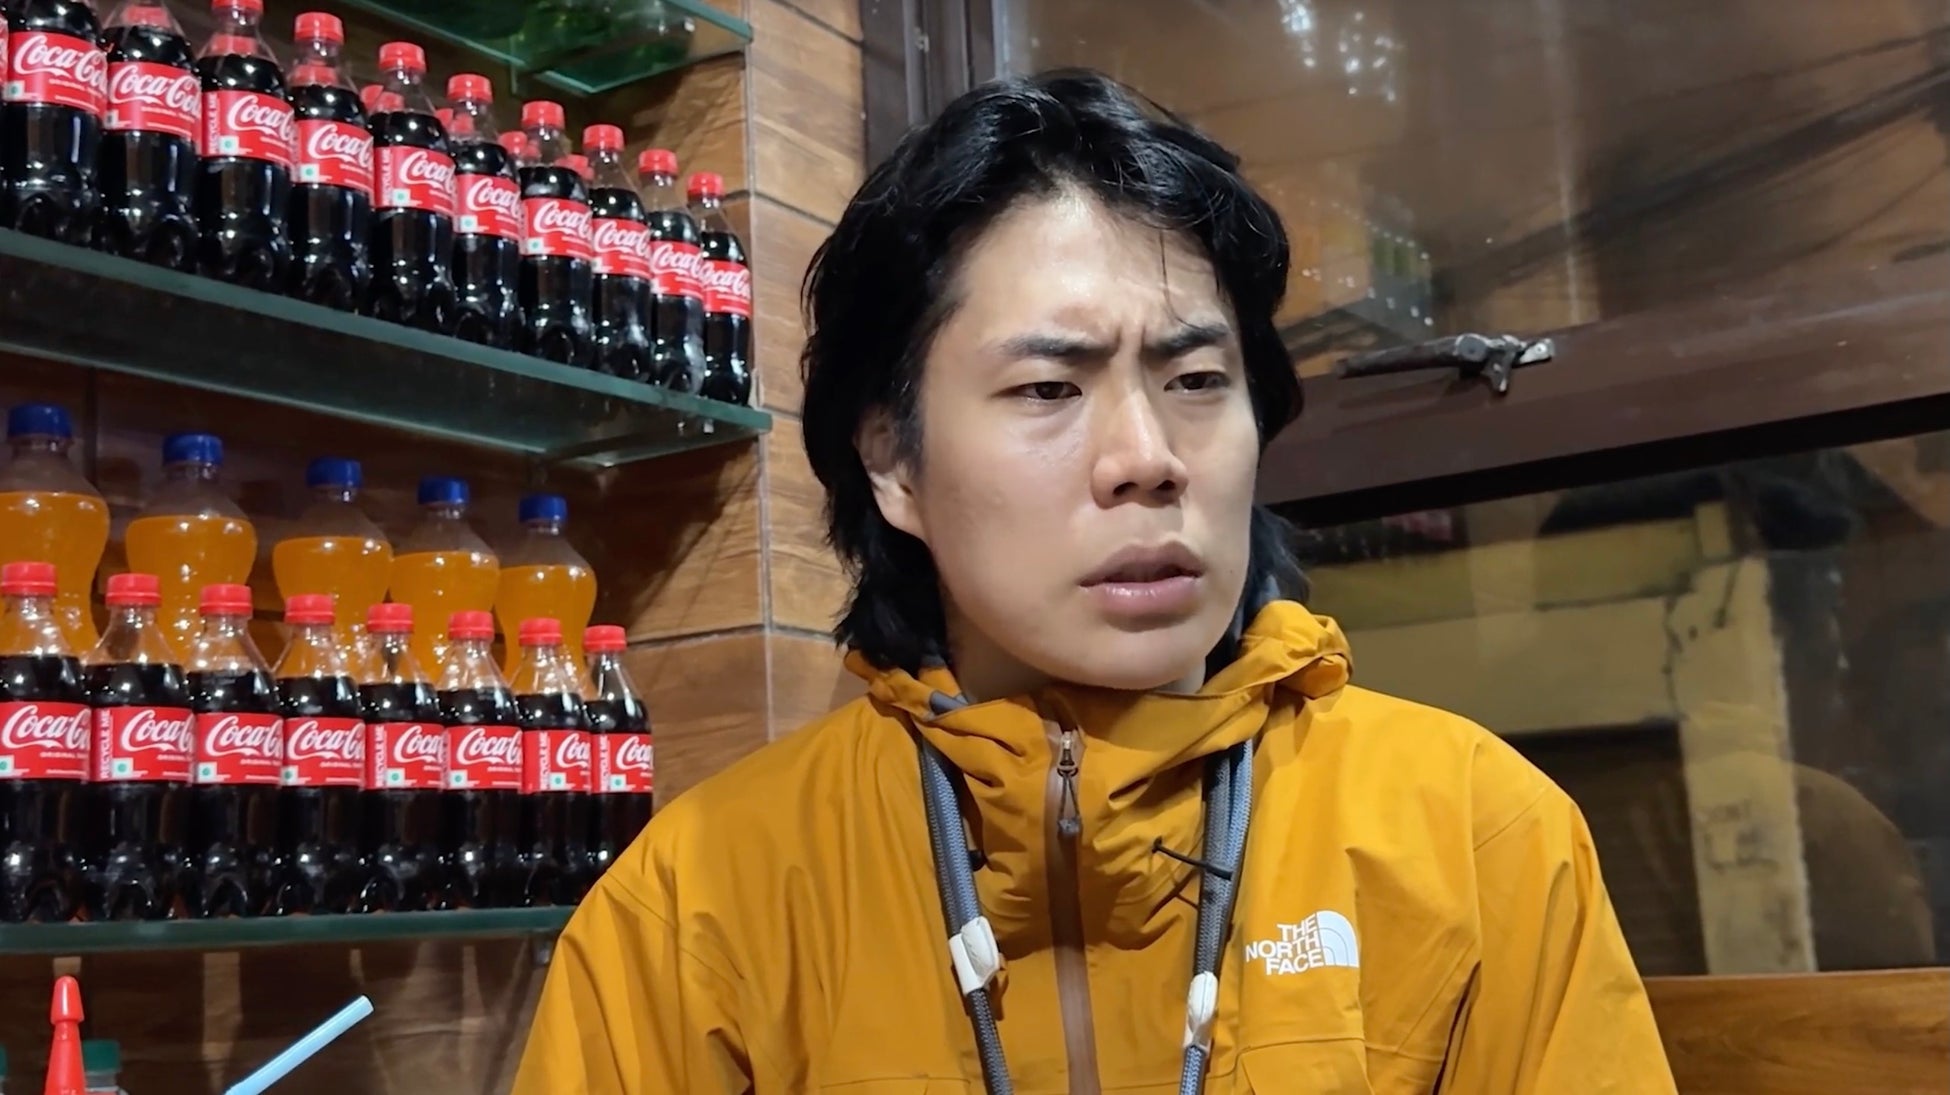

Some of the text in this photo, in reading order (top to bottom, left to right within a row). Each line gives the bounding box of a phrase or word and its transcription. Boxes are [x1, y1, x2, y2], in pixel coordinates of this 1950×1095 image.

[121, 709, 194, 753] Coca-C
[1277, 914, 1317, 941] THE
[1245, 931, 1320, 962] NORTH
[1266, 949, 1324, 976] FACE
